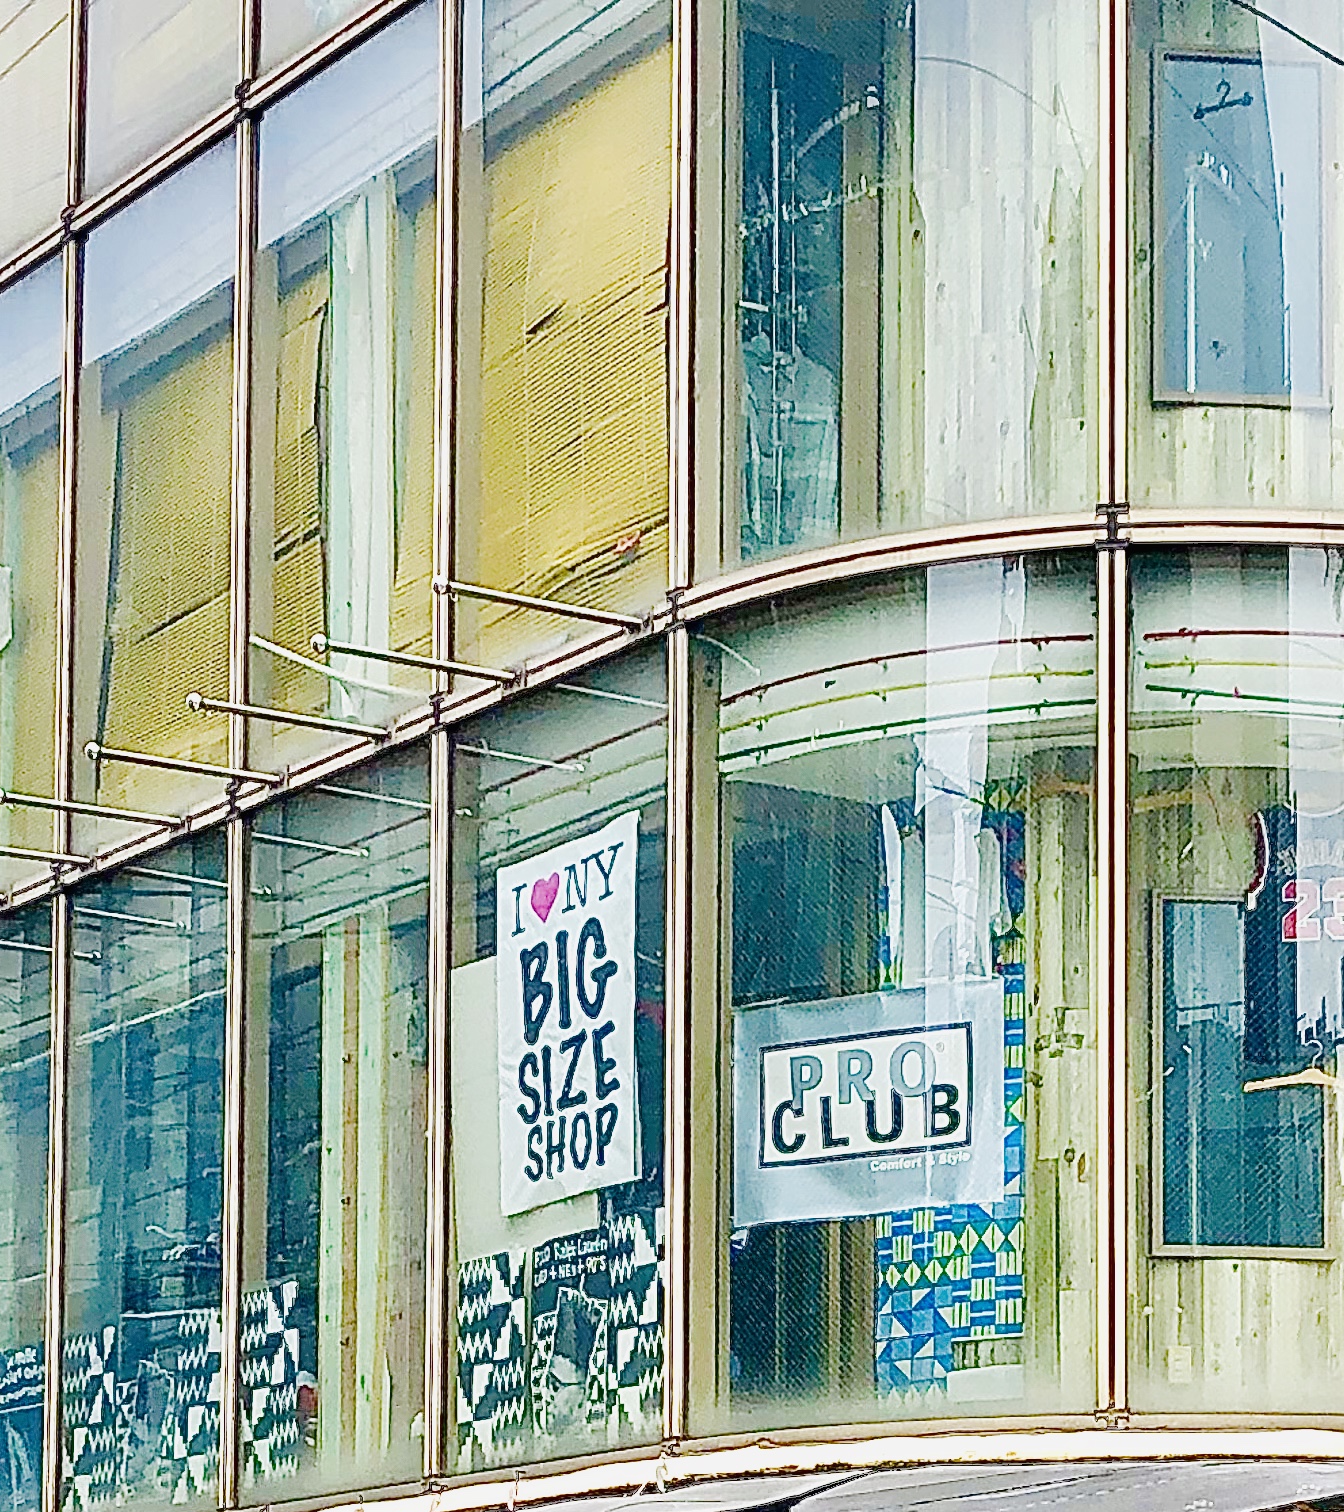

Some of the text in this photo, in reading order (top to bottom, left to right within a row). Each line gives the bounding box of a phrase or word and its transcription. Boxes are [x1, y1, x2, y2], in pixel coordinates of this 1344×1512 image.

[511, 842, 625, 937] I NY
[519, 916, 618, 1045] BIG
[517, 1021, 618, 1126] SIZE
[790, 1040, 938, 1107] PRO
[525, 1102, 618, 1184] SHOP
[770, 1082, 962, 1155] CLUB
[870, 1157, 922, 1172] Comfort
